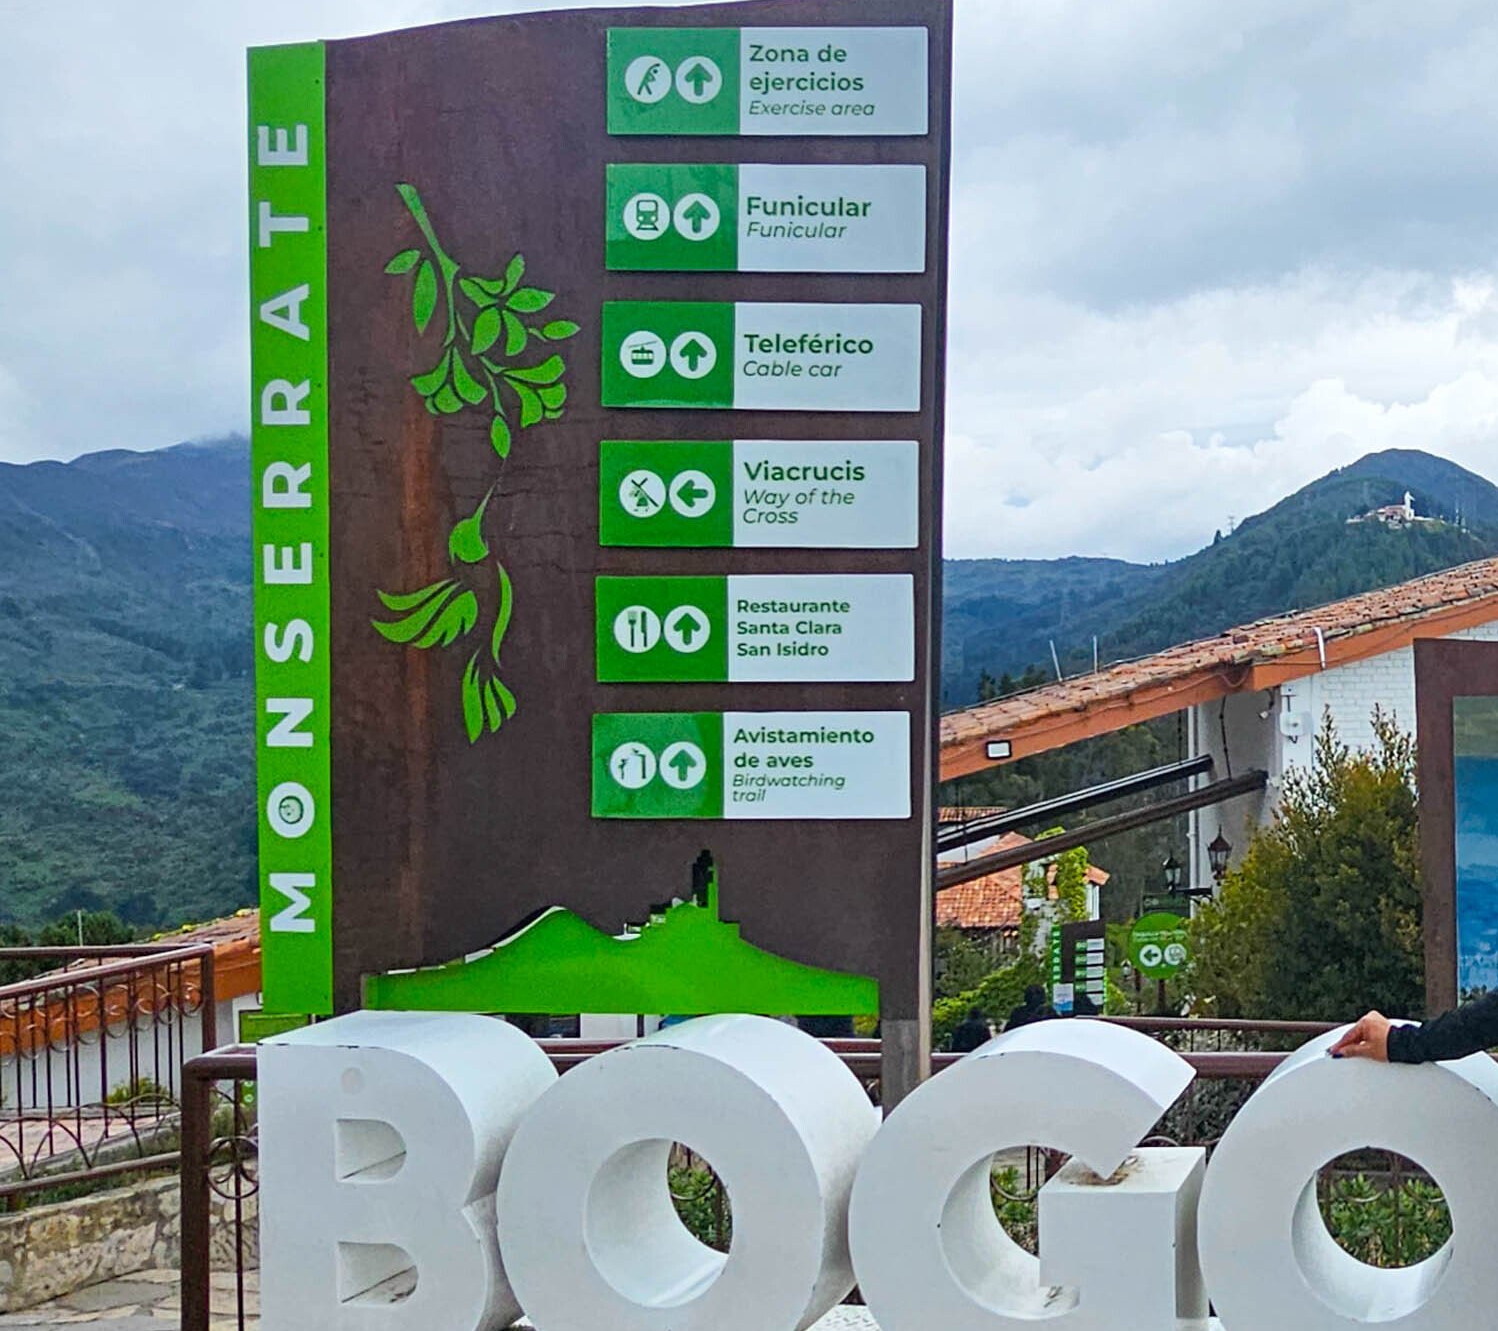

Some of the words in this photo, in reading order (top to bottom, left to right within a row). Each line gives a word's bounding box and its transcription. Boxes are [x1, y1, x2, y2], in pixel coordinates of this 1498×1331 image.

[750, 45, 809, 62] Zona
[818, 45, 847, 62] de
[750, 71, 864, 95] ejercicios
[749, 100, 826, 115] Exercise
[831, 104, 875, 116] area
[747, 195, 871, 217] Funicular
[747, 221, 847, 238] Funicular
[744, 333, 873, 354] Teleférico
[743, 360, 802, 376] Cable
[809, 365, 842, 377] car
[744, 460, 865, 481] Viacrucis
[744, 490, 790, 508] Way
[795, 488, 817, 505] of
[822, 489, 855, 504] the
[743, 506, 798, 524] Cross
[259, 122, 317, 934] MONSERRATE
[738, 600, 850, 613] Restaurante
[737, 621, 789, 634] Santa
[796, 621, 842, 634] Clara
[737, 643, 771, 656] San
[777, 641, 829, 656] Isidro
[733, 727, 874, 743] Avistamiento
[734, 752, 759, 768] de
[766, 756, 813, 768] aves
[733, 773, 845, 790] Birdwatching
[733, 789, 766, 802] trail
